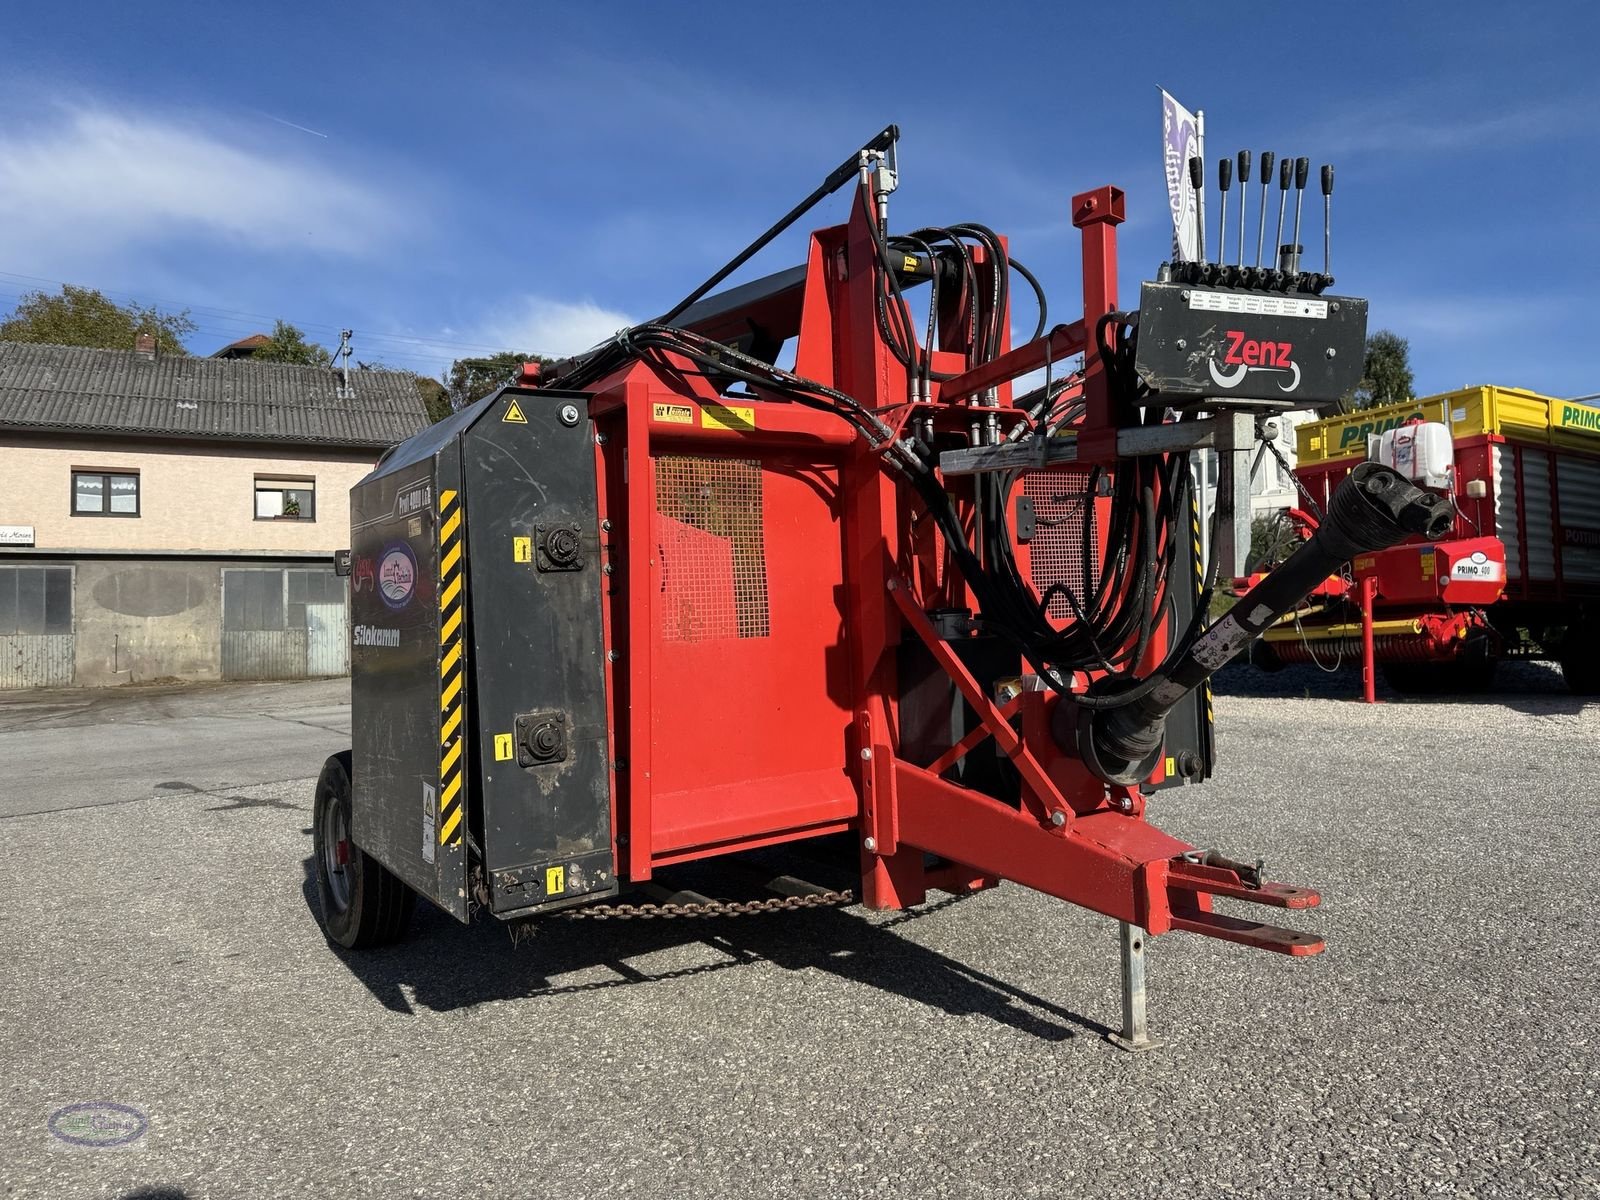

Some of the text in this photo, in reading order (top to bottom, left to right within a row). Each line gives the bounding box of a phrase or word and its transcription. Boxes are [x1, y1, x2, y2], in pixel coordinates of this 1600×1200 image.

[1225, 330, 1292, 368] Zenz
[1457, 566, 1491, 575] PRIMO 400
[353, 624, 400, 647] Silokamm
